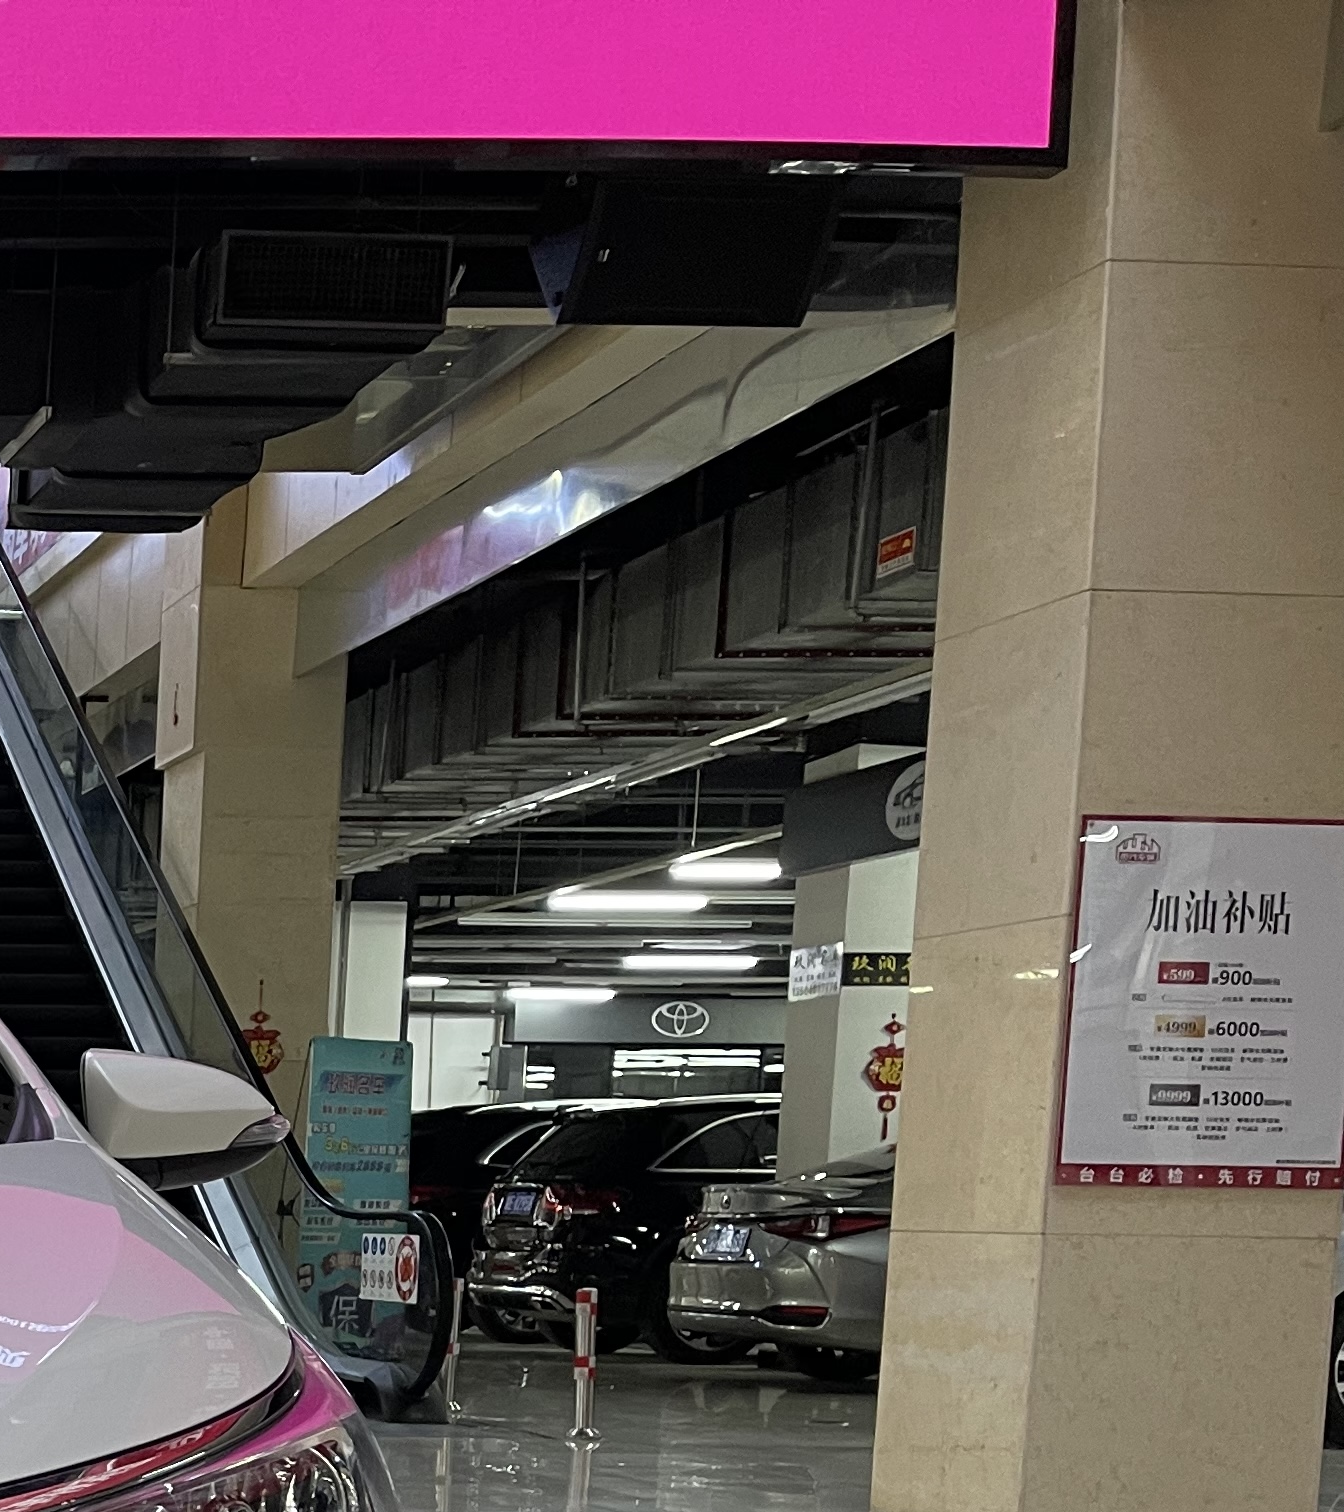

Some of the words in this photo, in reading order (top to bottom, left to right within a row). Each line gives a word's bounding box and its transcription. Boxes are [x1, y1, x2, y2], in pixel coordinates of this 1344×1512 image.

[1144, 888, 1292, 936] 加油补贴
[1219, 969, 1253, 986] 900
[1215, 1020, 1260, 1037] 6000
[1211, 1090, 1264, 1107] 13000
[330, 1294, 360, 1334] 保
